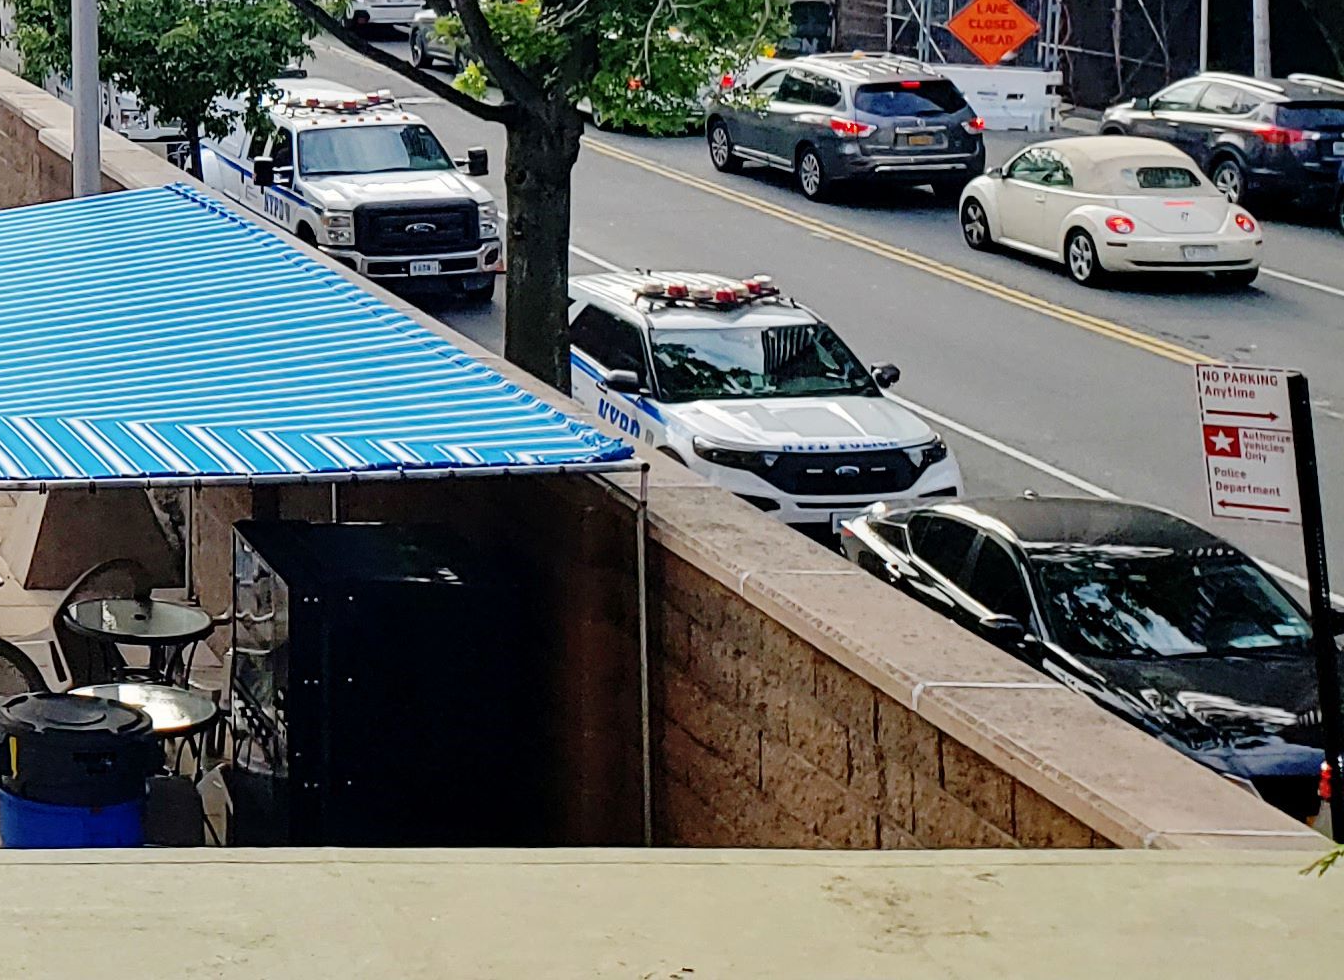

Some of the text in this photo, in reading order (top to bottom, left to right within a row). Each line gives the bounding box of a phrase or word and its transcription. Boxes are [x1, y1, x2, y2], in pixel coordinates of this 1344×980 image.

[977, 3, 1009, 14] LANE
[968, 19, 1017, 30] CLOSED
[972, 34, 1014, 45] AHEAD
[1202, 370, 1278, 387] NO PARKING
[1204, 385, 1256, 399] Anytime
[1242, 430, 1292, 443] Authorize
[1243, 442, 1285, 454] Vehicles
[1244, 451, 1267, 464] Only
[1214, 466, 1247, 480] Police
[1215, 480, 1281, 497] Department
